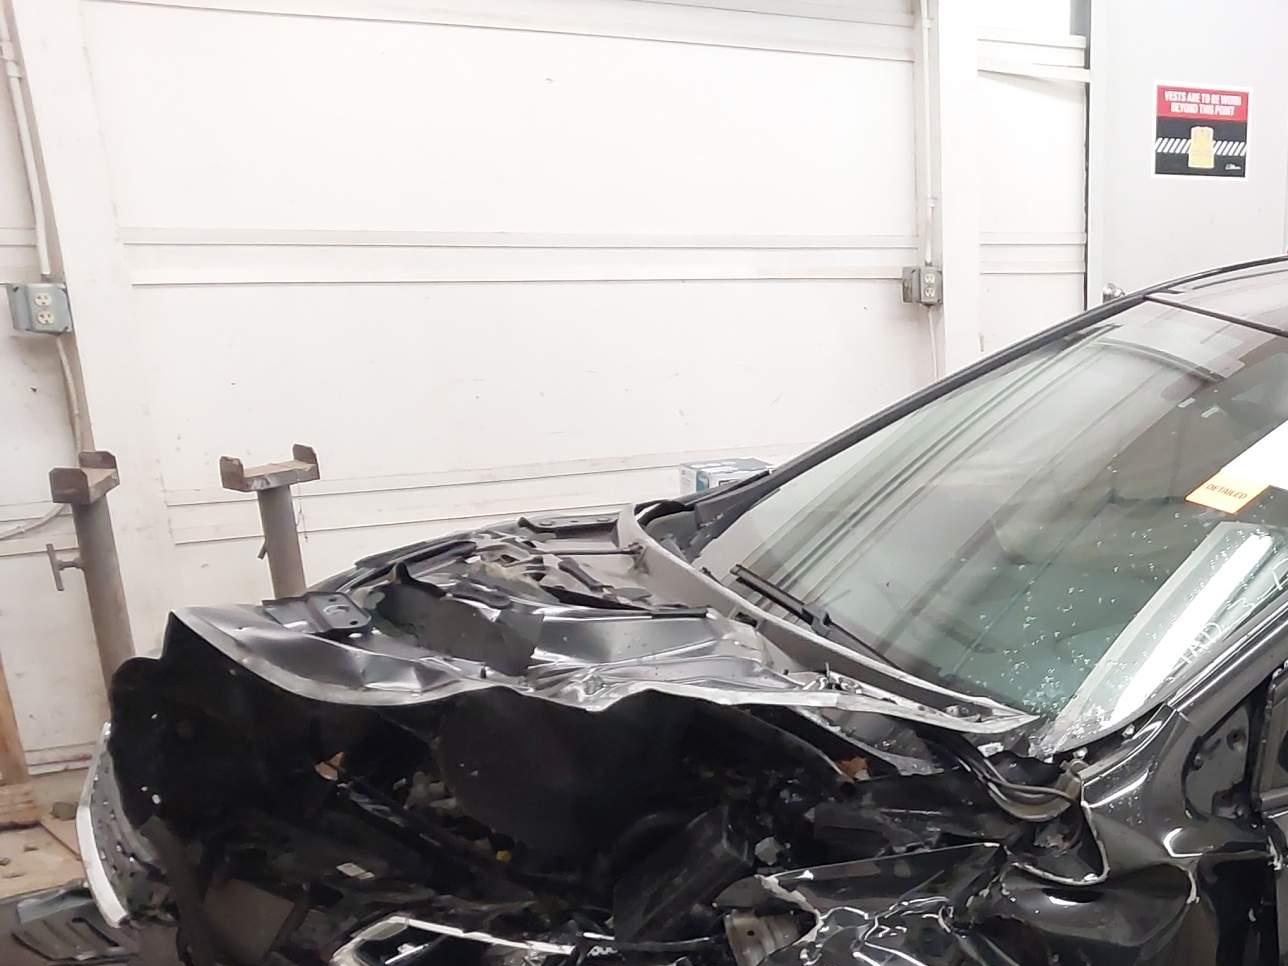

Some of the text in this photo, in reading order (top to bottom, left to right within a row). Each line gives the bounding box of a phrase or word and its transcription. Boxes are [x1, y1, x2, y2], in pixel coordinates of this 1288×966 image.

[1164, 91, 1186, 102] VESTS
[1187, 92, 1200, 103] ARE
[1201, 93, 1211, 104] TO
[1211, 94, 1220, 104] BE
[1171, 102, 1198, 113] BEYOND
[1199, 103, 1214, 114] THIS
[1206, 483, 1248, 500] DETAILED
